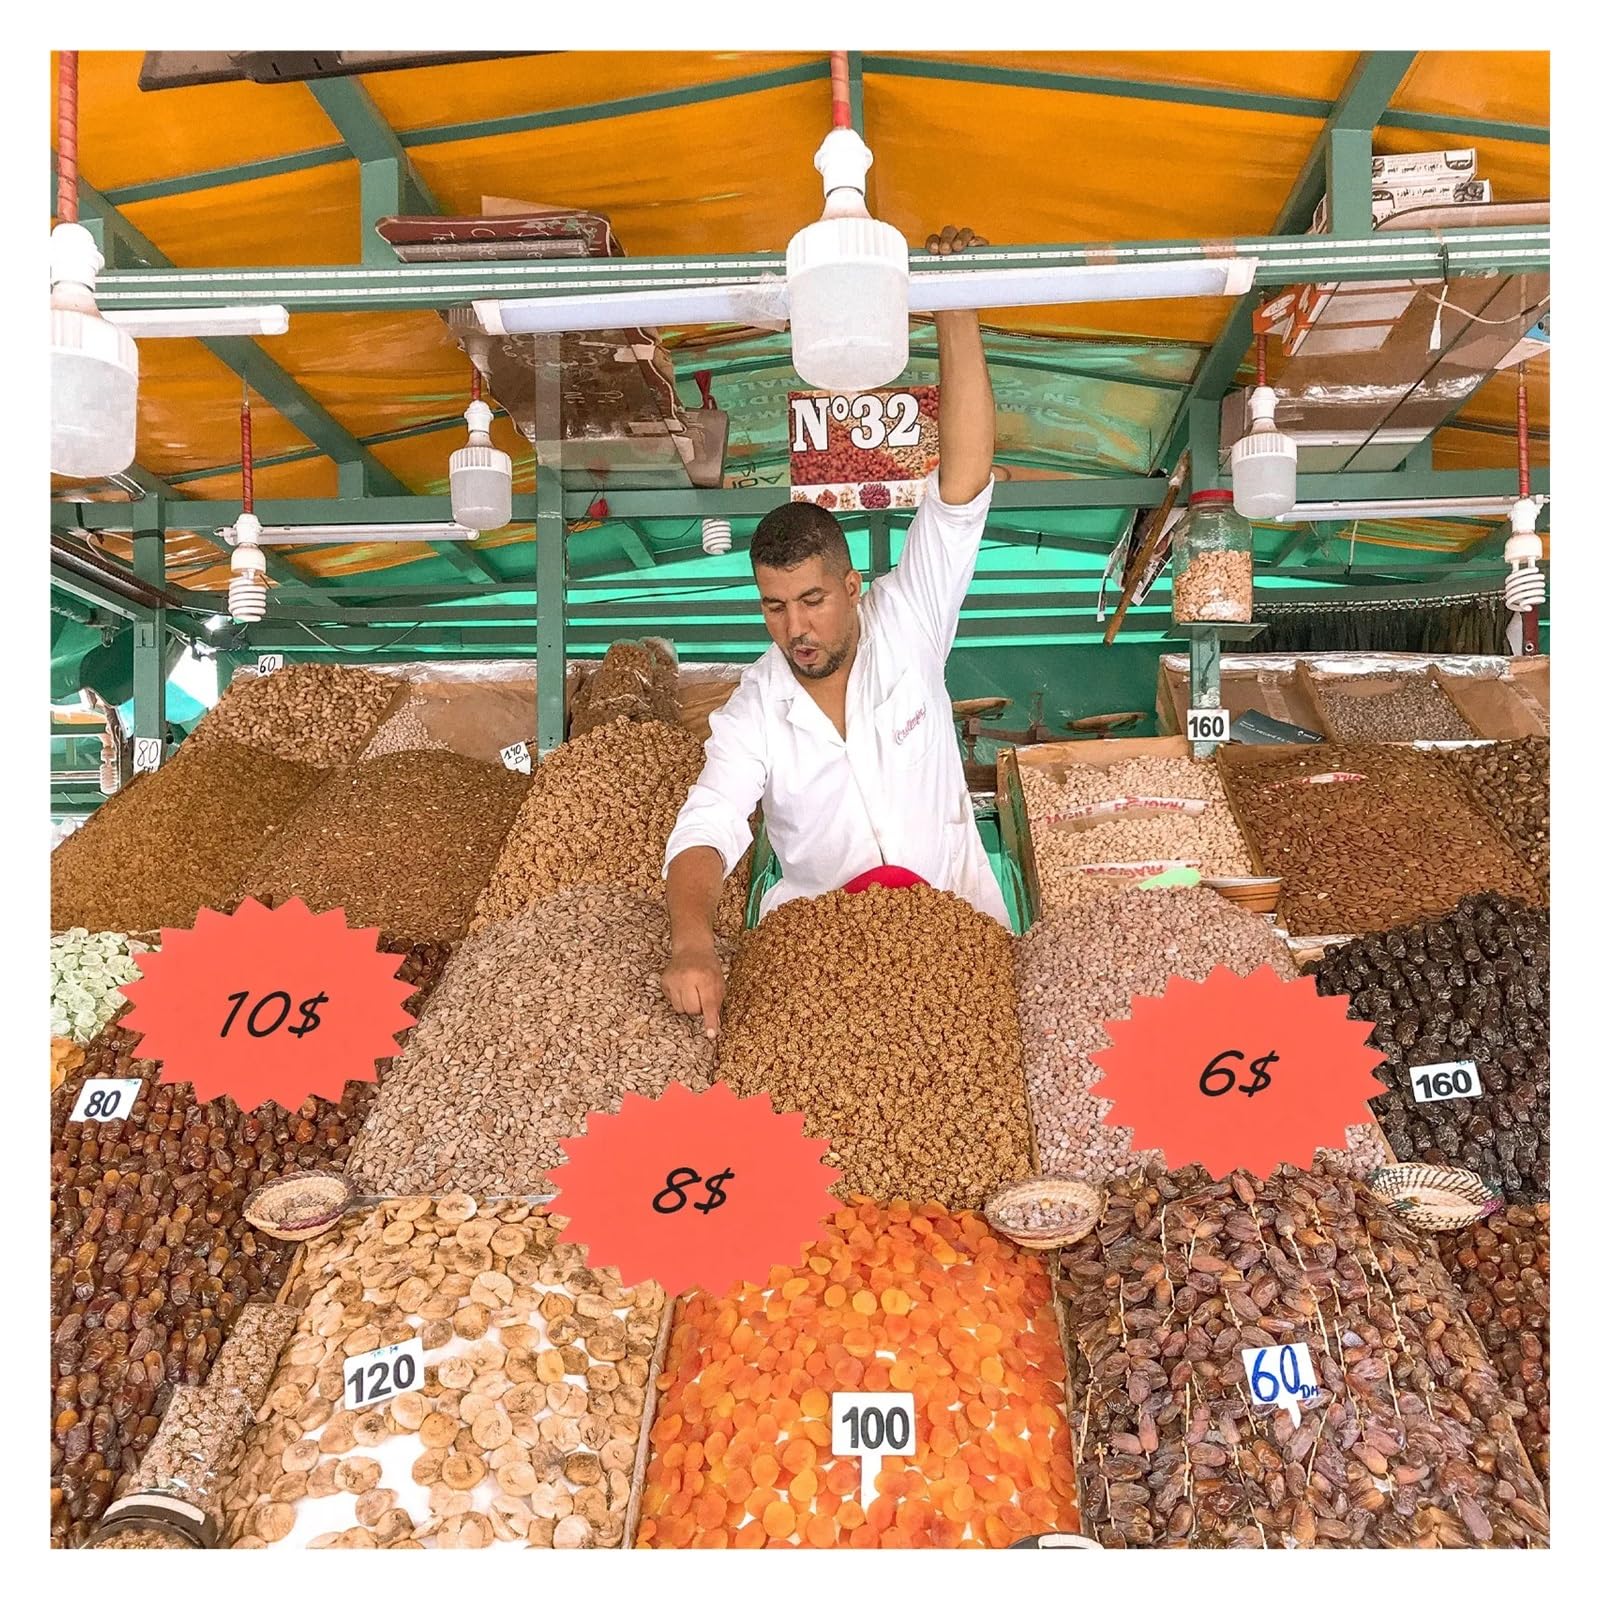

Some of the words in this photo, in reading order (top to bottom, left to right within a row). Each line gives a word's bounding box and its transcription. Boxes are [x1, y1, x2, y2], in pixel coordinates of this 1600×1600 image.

[260, 656, 275, 673] 60
[1188, 716, 1224, 738] 160
[137, 740, 159, 767] 80
[504, 744, 521, 760] 140
[1416, 1069, 1472, 1098] 160
[84, 1090, 121, 1117] 80
[347, 1354, 415, 1403] 120
[1252, 1345, 1300, 1402] 60
[841, 1406, 910, 1449] 100
